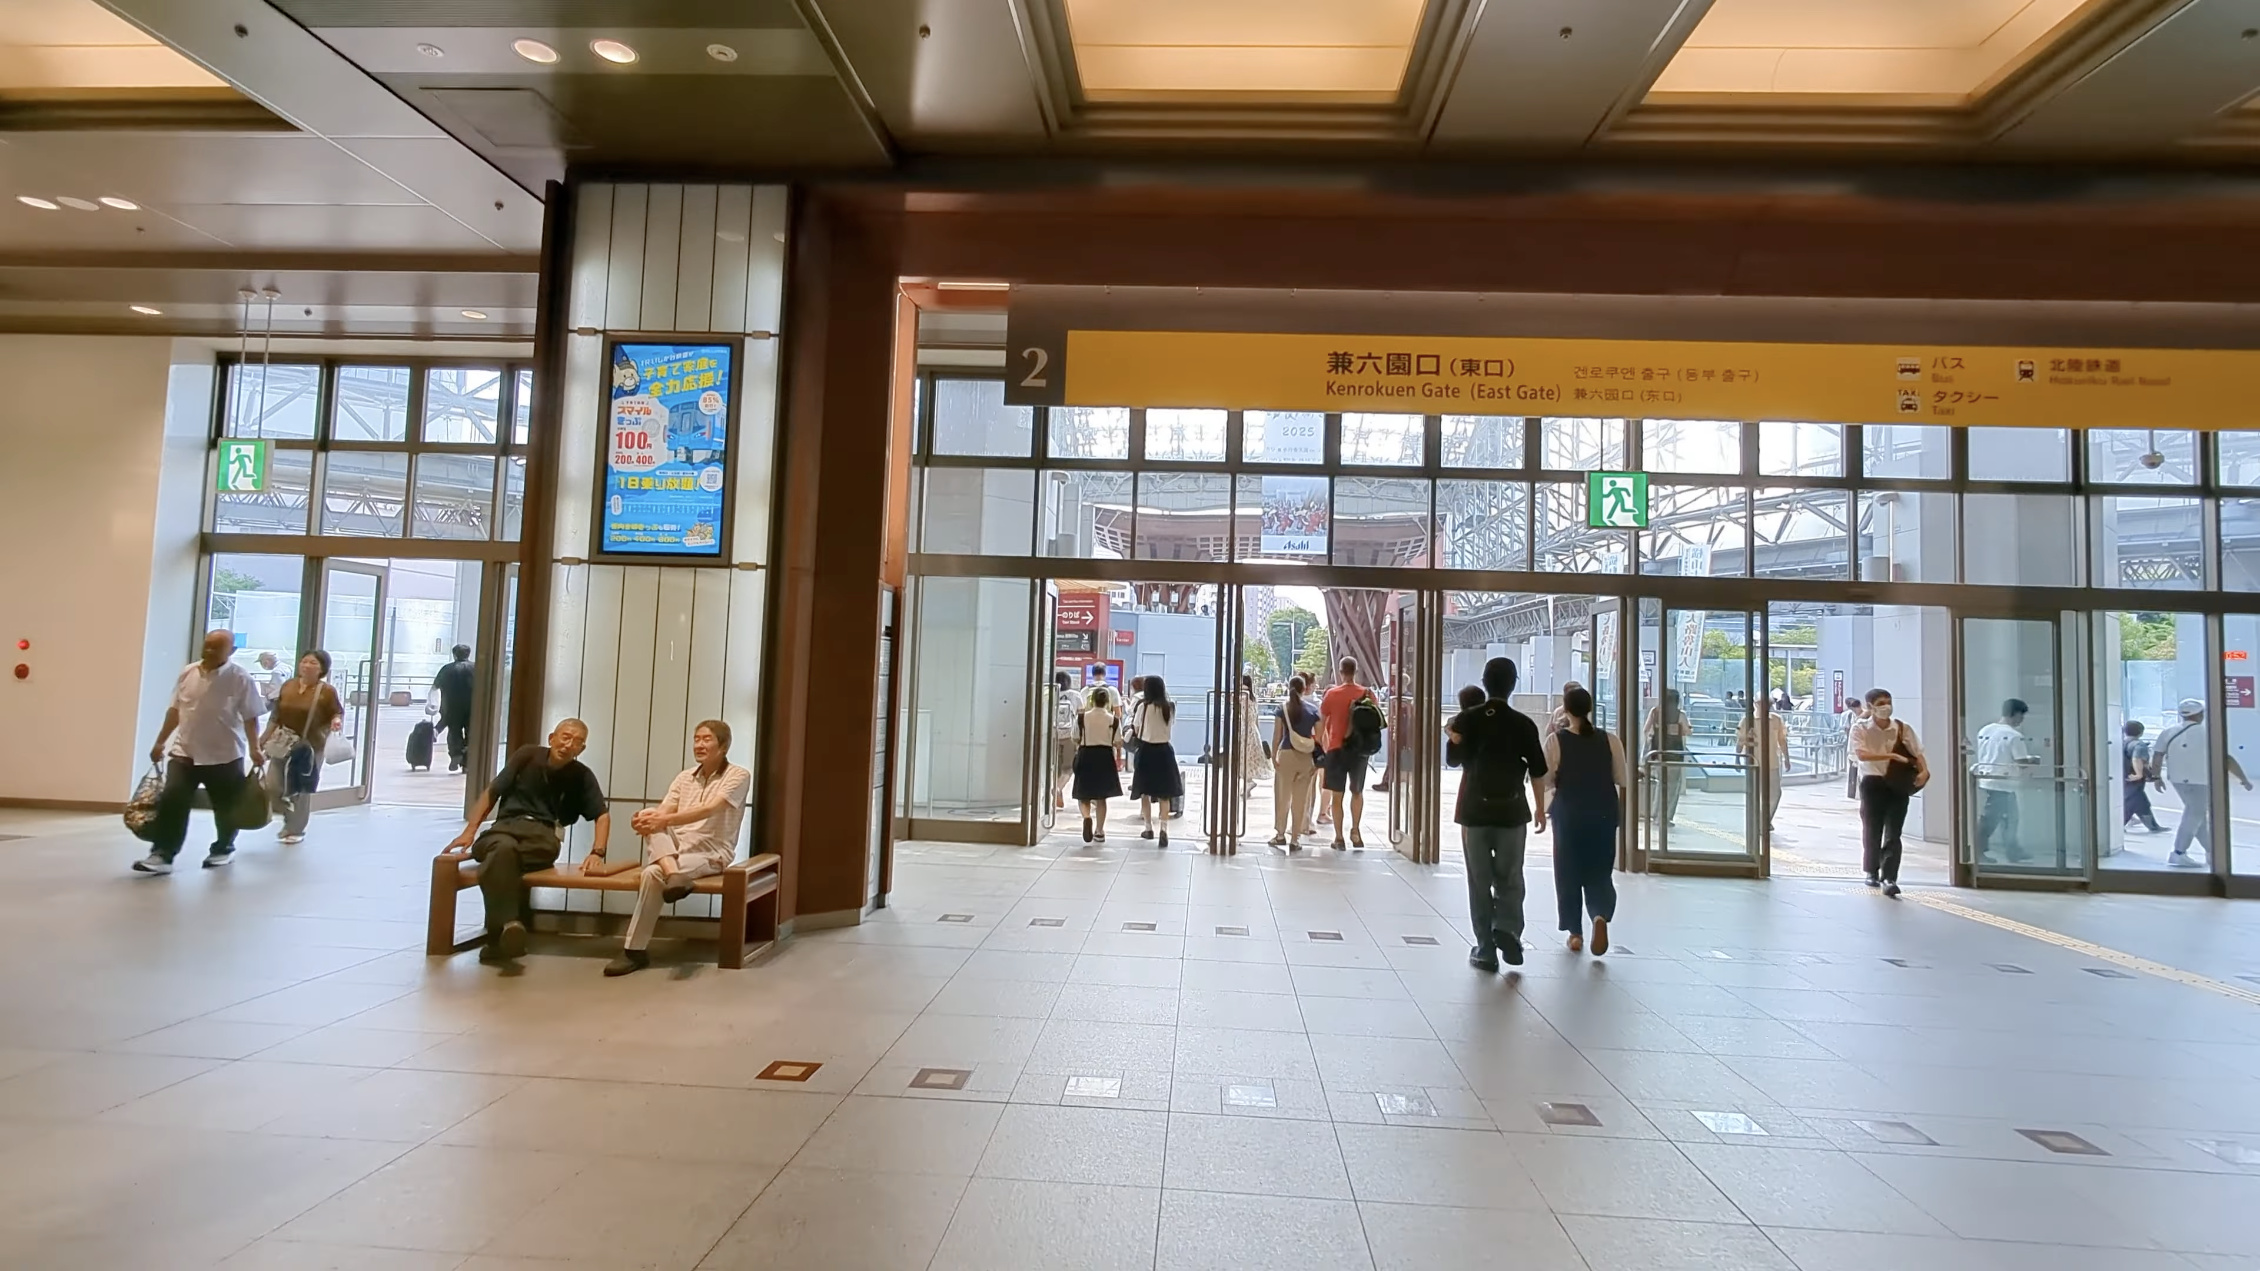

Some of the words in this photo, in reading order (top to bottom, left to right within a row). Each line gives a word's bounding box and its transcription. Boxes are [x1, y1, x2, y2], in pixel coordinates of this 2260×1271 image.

[1020, 347, 1048, 388] 2
[1932, 356, 1965, 369] バス
[1573, 366, 1636, 380] 겐로쿠엔
[1641, 367, 1671, 381] 출구
[1722, 369, 1760, 383] 출구)
[1326, 380, 1416, 397] Kenrokuen
[1421, 382, 1461, 399] Gate
[1470, 382, 1512, 401] (East
[1516, 384, 1562, 402] Gate)
[1933, 390, 1999, 403] タクシー
[617, 406, 652, 416] スマイル
[1282, 426, 1316, 438] 2025
[1283, 540, 1310, 551] Asahi
